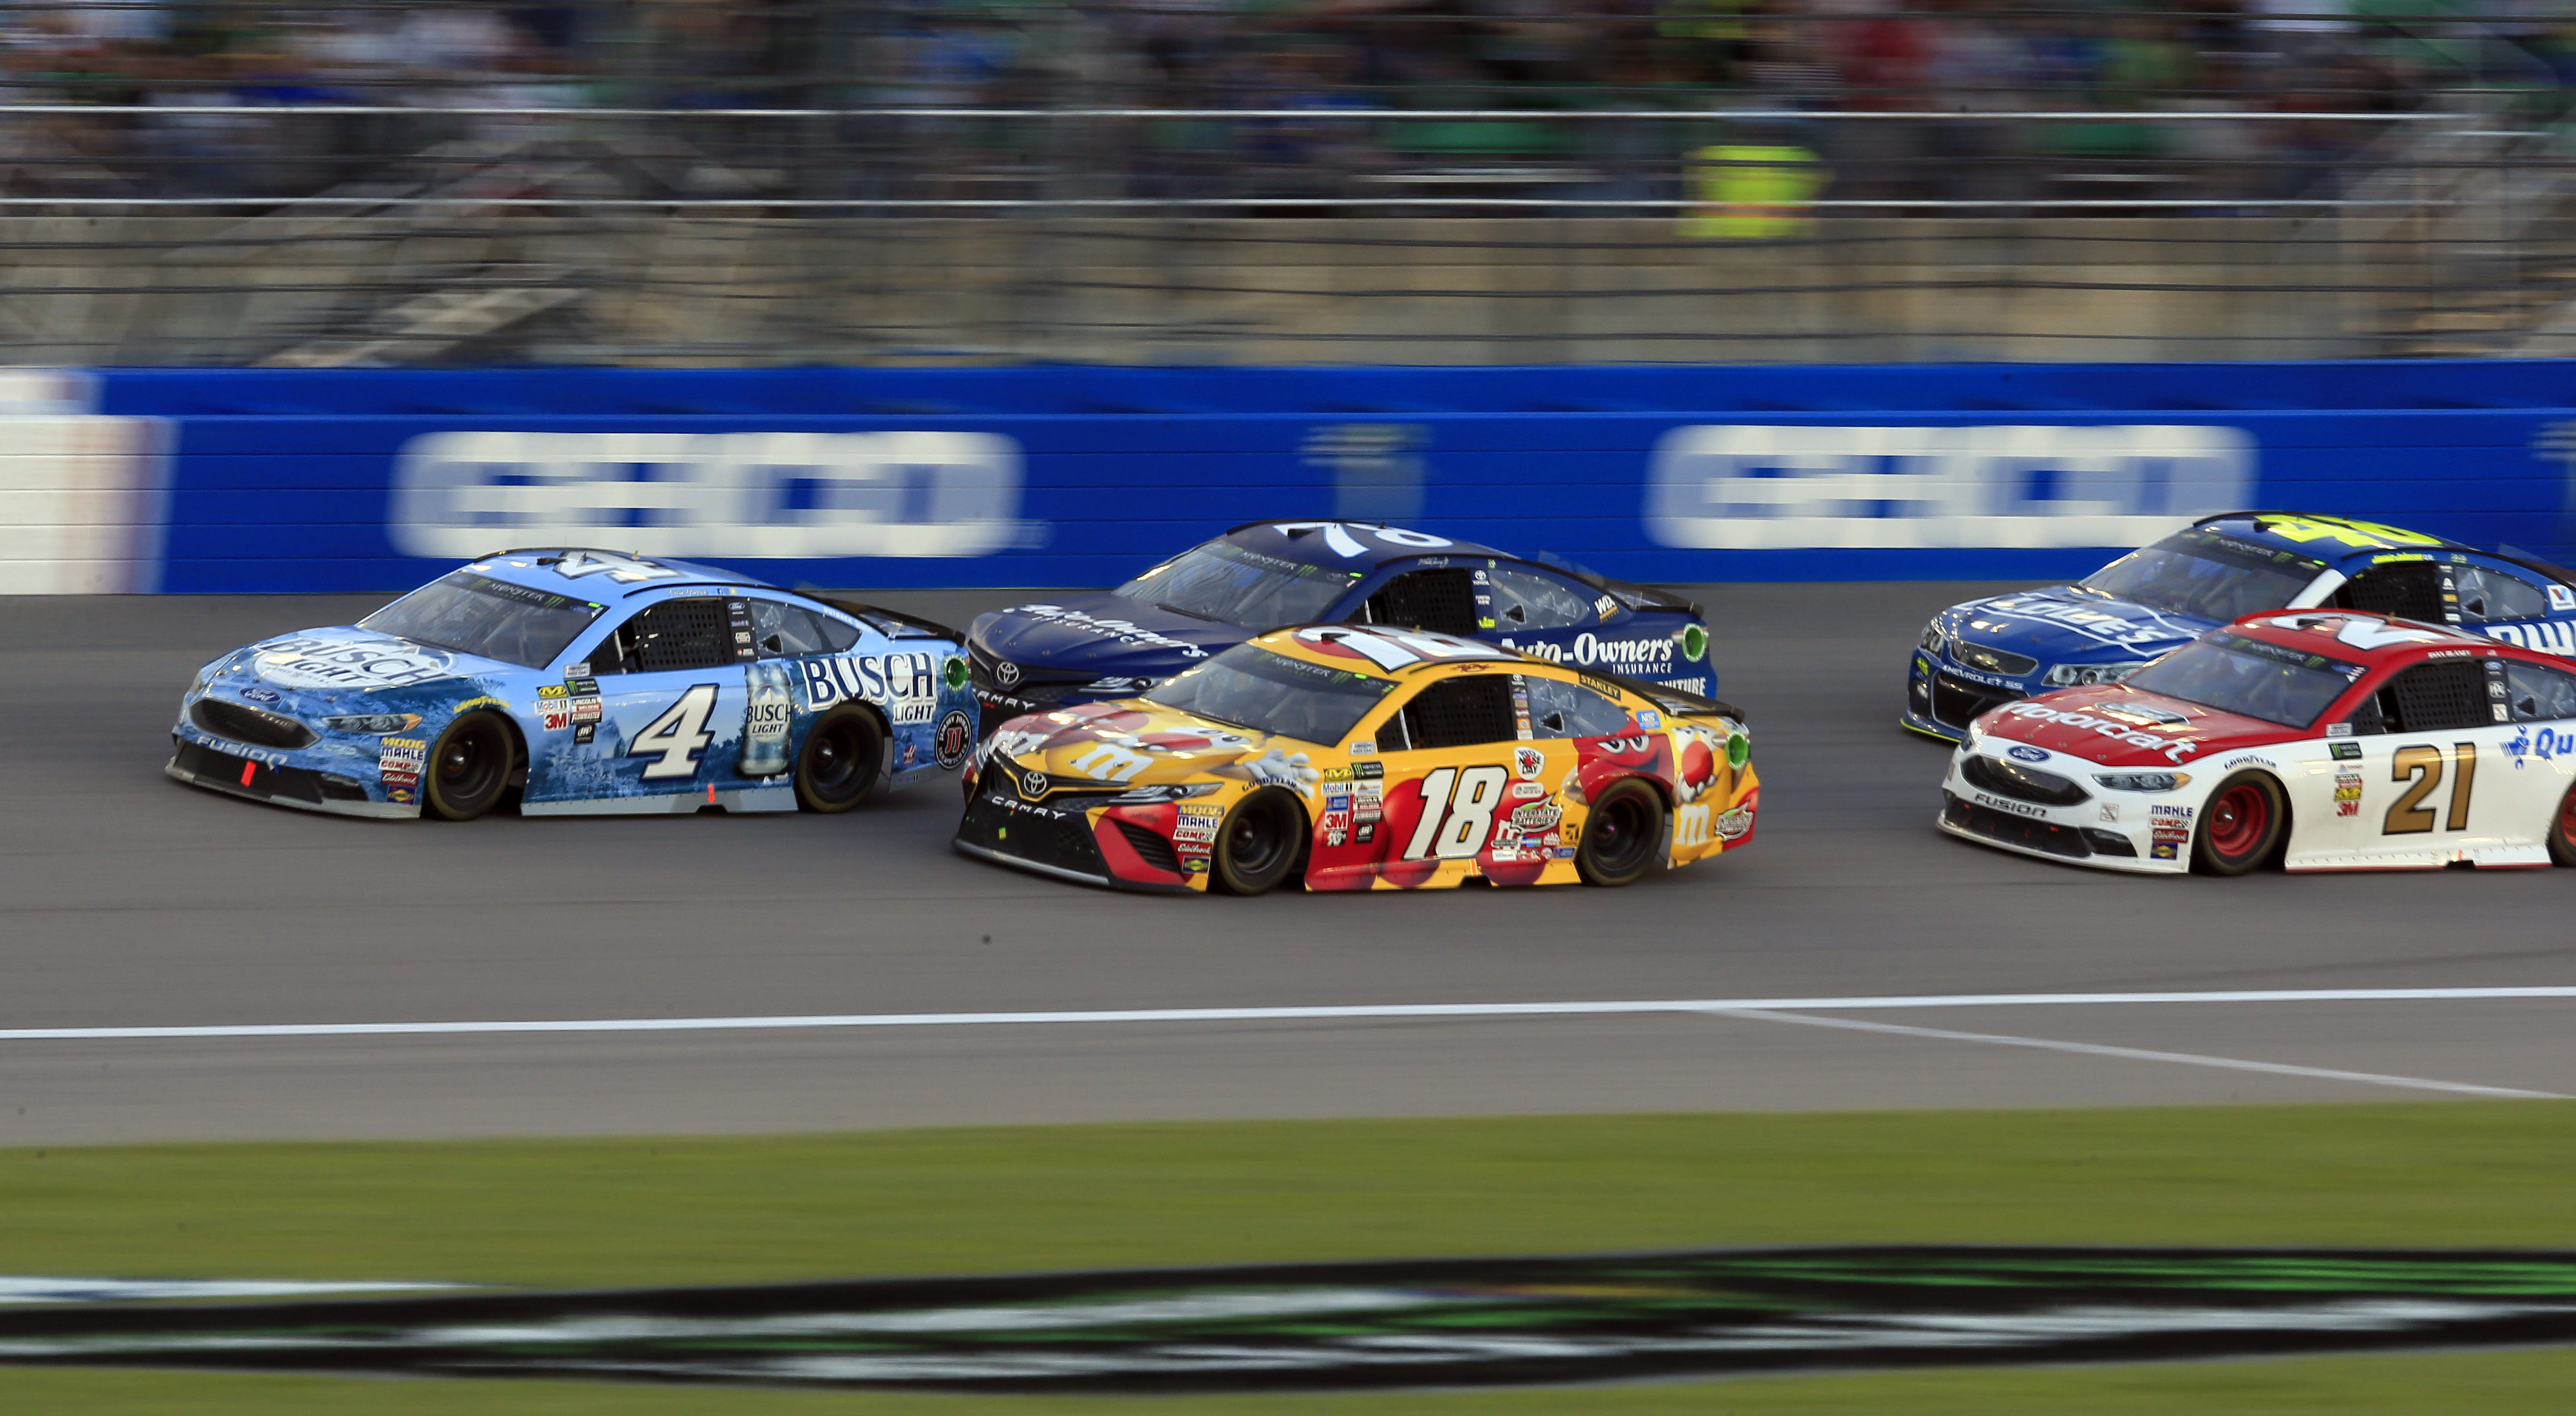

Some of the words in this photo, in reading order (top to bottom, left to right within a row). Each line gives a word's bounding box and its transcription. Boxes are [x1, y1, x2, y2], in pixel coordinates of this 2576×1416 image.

[1273, 522, 1454, 558] 78
[489, 582, 546, 601] MONSTER
[1594, 594, 1615, 614] WIX
[1272, 657, 1331, 677] MONSTER
[1613, 663, 1672, 674] INSURANCE
[1943, 664, 2002, 687] CHEVROLET
[802, 652, 935, 708] BUSCH
[1581, 674, 1619, 697] STANLEY
[244, 688, 274, 702] Ford
[545, 713, 567, 730] 3M
[747, 704, 792, 724] BUSCH
[894, 704, 933, 722] LIGHT
[629, 684, 720, 780] 4
[752, 723, 783, 733] LIGHT
[197, 736, 289, 766] FUSION
[381, 737, 426, 749] MOOG
[2536, 728, 2576, 760] Qu
[381, 747, 425, 761] MAHLE
[2013, 747, 2044, 761] Ford
[381, 760, 410, 770] COMP
[1522, 766, 1537, 774] DAY
[2224, 755, 2277, 771] GOODYEAR
[1242, 775, 1297, 791] GOODYEAR
[1323, 783, 1344, 793] Mobil
[2382, 742, 2476, 835] 21
[992, 796, 1067, 820] CAMRY
[1404, 767, 1507, 860] 18
[1514, 809, 1558, 818] INTERSTATE
[1975, 793, 2047, 818] FUSION
[2151, 804, 2193, 818] MAHLE
[1178, 816, 1217, 828] MAHLE
[1325, 813, 1347, 829] 3M
[1514, 817, 1555, 825] BATTERIES
[1675, 803, 1710, 846] m
[1178, 843, 1211, 854] Edelbrock
